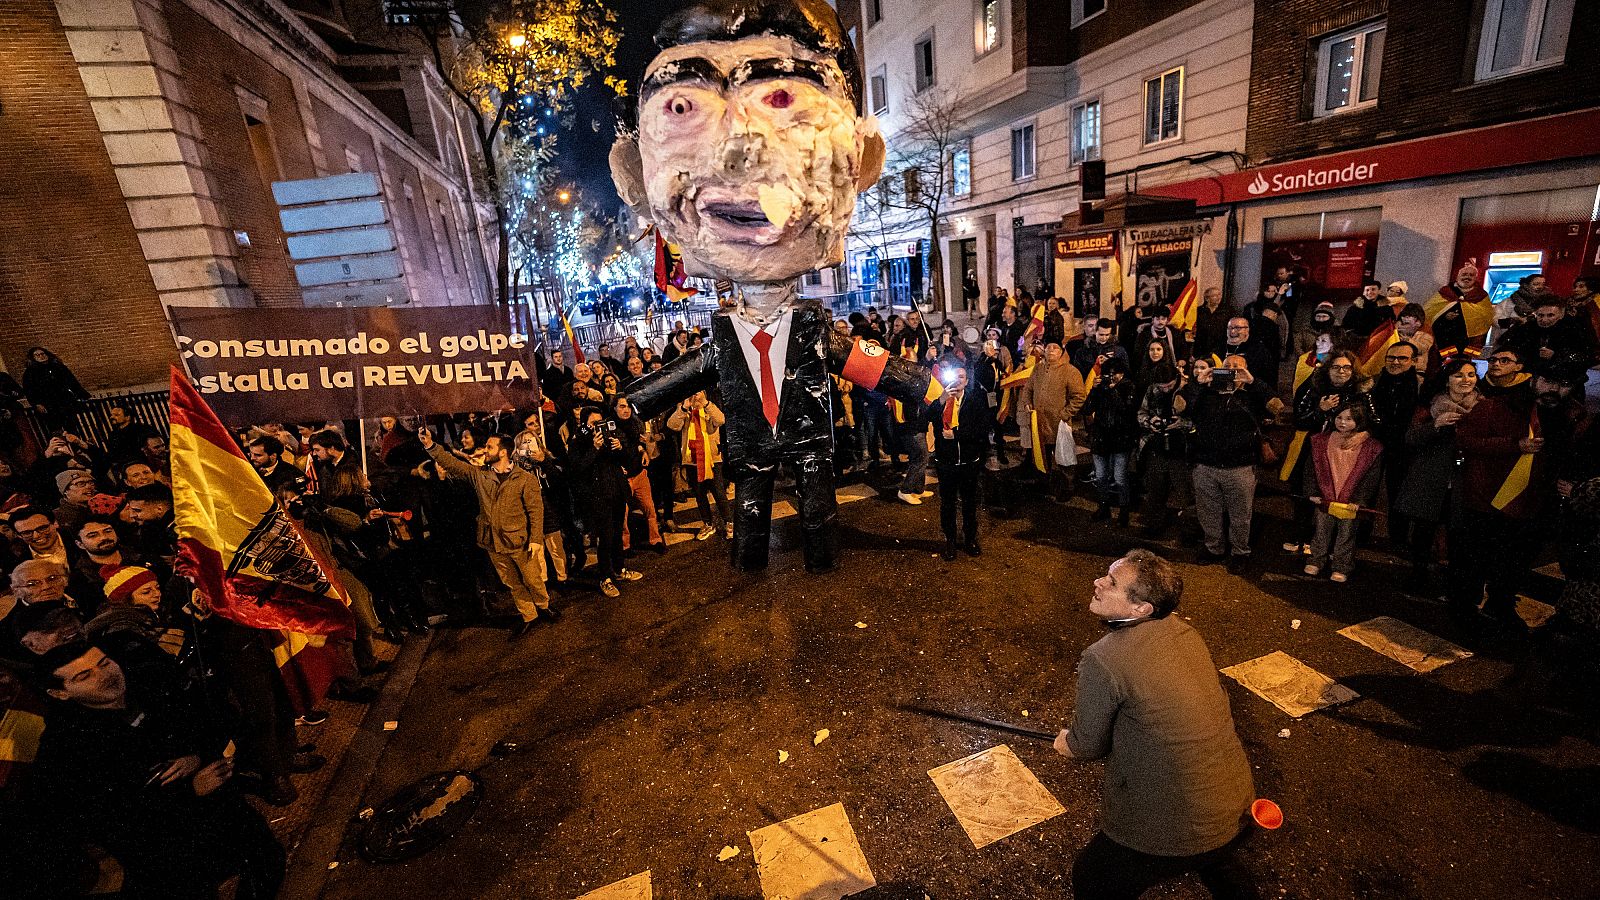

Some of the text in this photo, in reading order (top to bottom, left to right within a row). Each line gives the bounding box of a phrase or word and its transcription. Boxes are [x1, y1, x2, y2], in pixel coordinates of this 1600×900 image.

[1272, 162, 1378, 192] Santander
[1068, 237, 1108, 250] TABACOS
[1151, 240, 1191, 254] TABACOS
[177, 329, 526, 358] Consumado el golpe
[320, 366, 354, 389] la
[363, 360, 530, 387] REVUELTA
